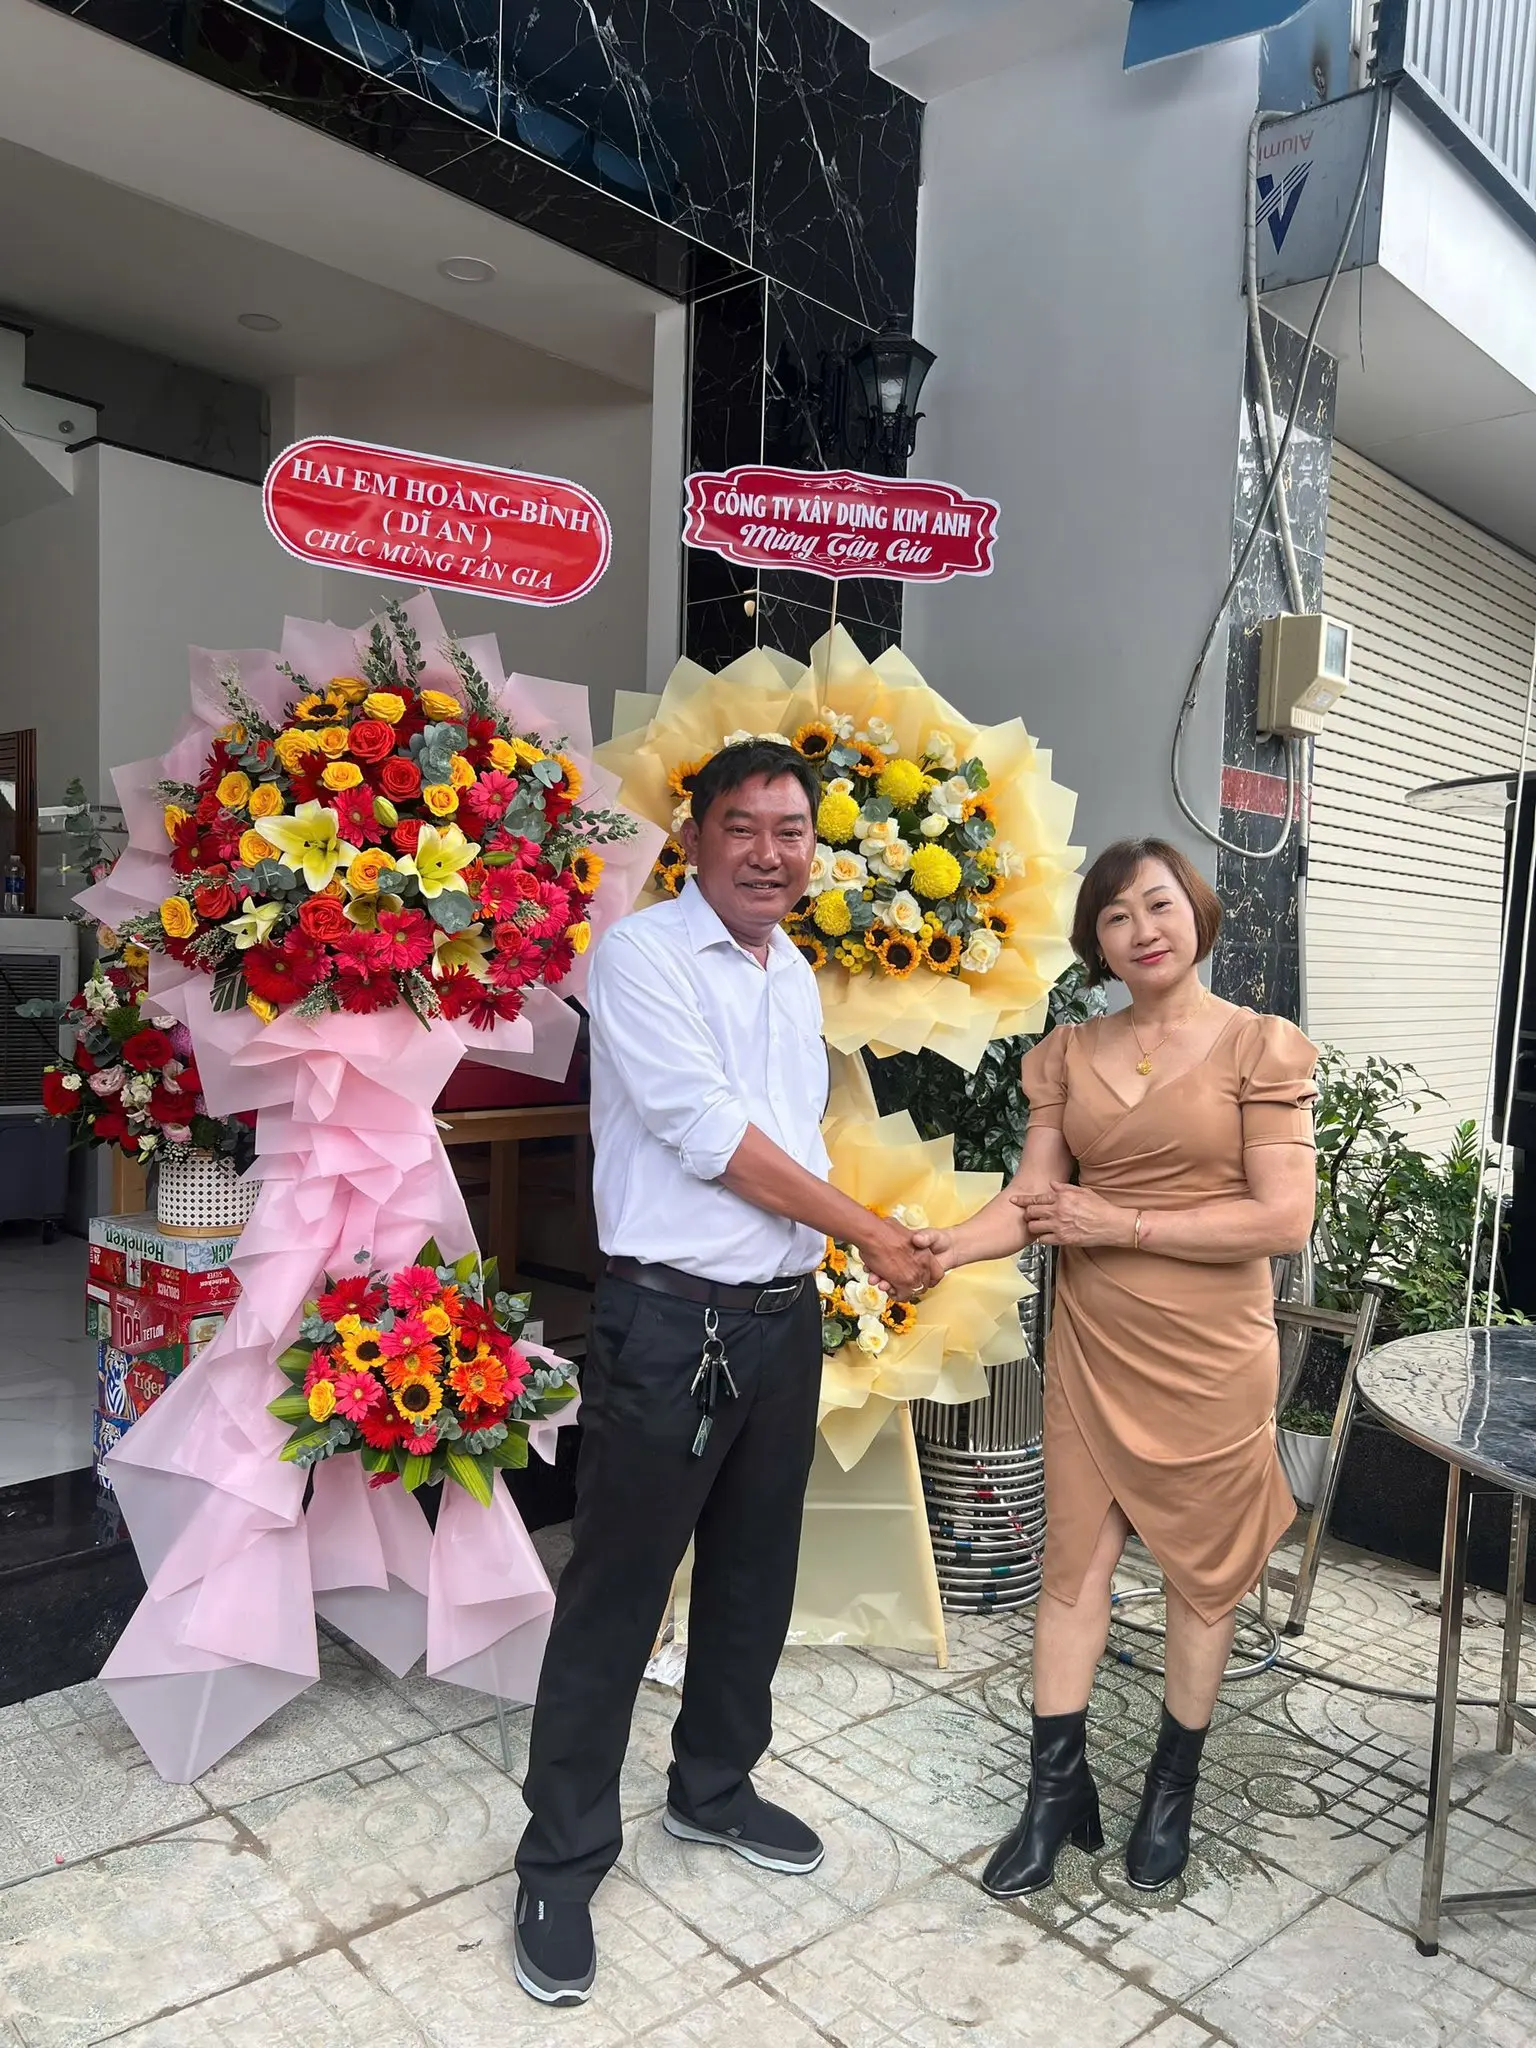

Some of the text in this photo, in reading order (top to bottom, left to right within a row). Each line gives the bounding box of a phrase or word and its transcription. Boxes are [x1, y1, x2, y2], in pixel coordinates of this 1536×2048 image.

[290, 457, 592, 533] HAI EM HOÀNG-BÌNH
[713, 486, 972, 538] CÔNG TY XÂY DỰNG KIM ANH
[398, 509, 432, 537] DĨ
[434, 519, 477, 545] AN
[740, 523, 933, 564] Mừng Tân Gia
[304, 528, 553, 591] CHÚC MỪNG TÂN GIA
[105, 1229, 165, 1263] Heineken
[133, 1370, 165, 1400] Tiger
